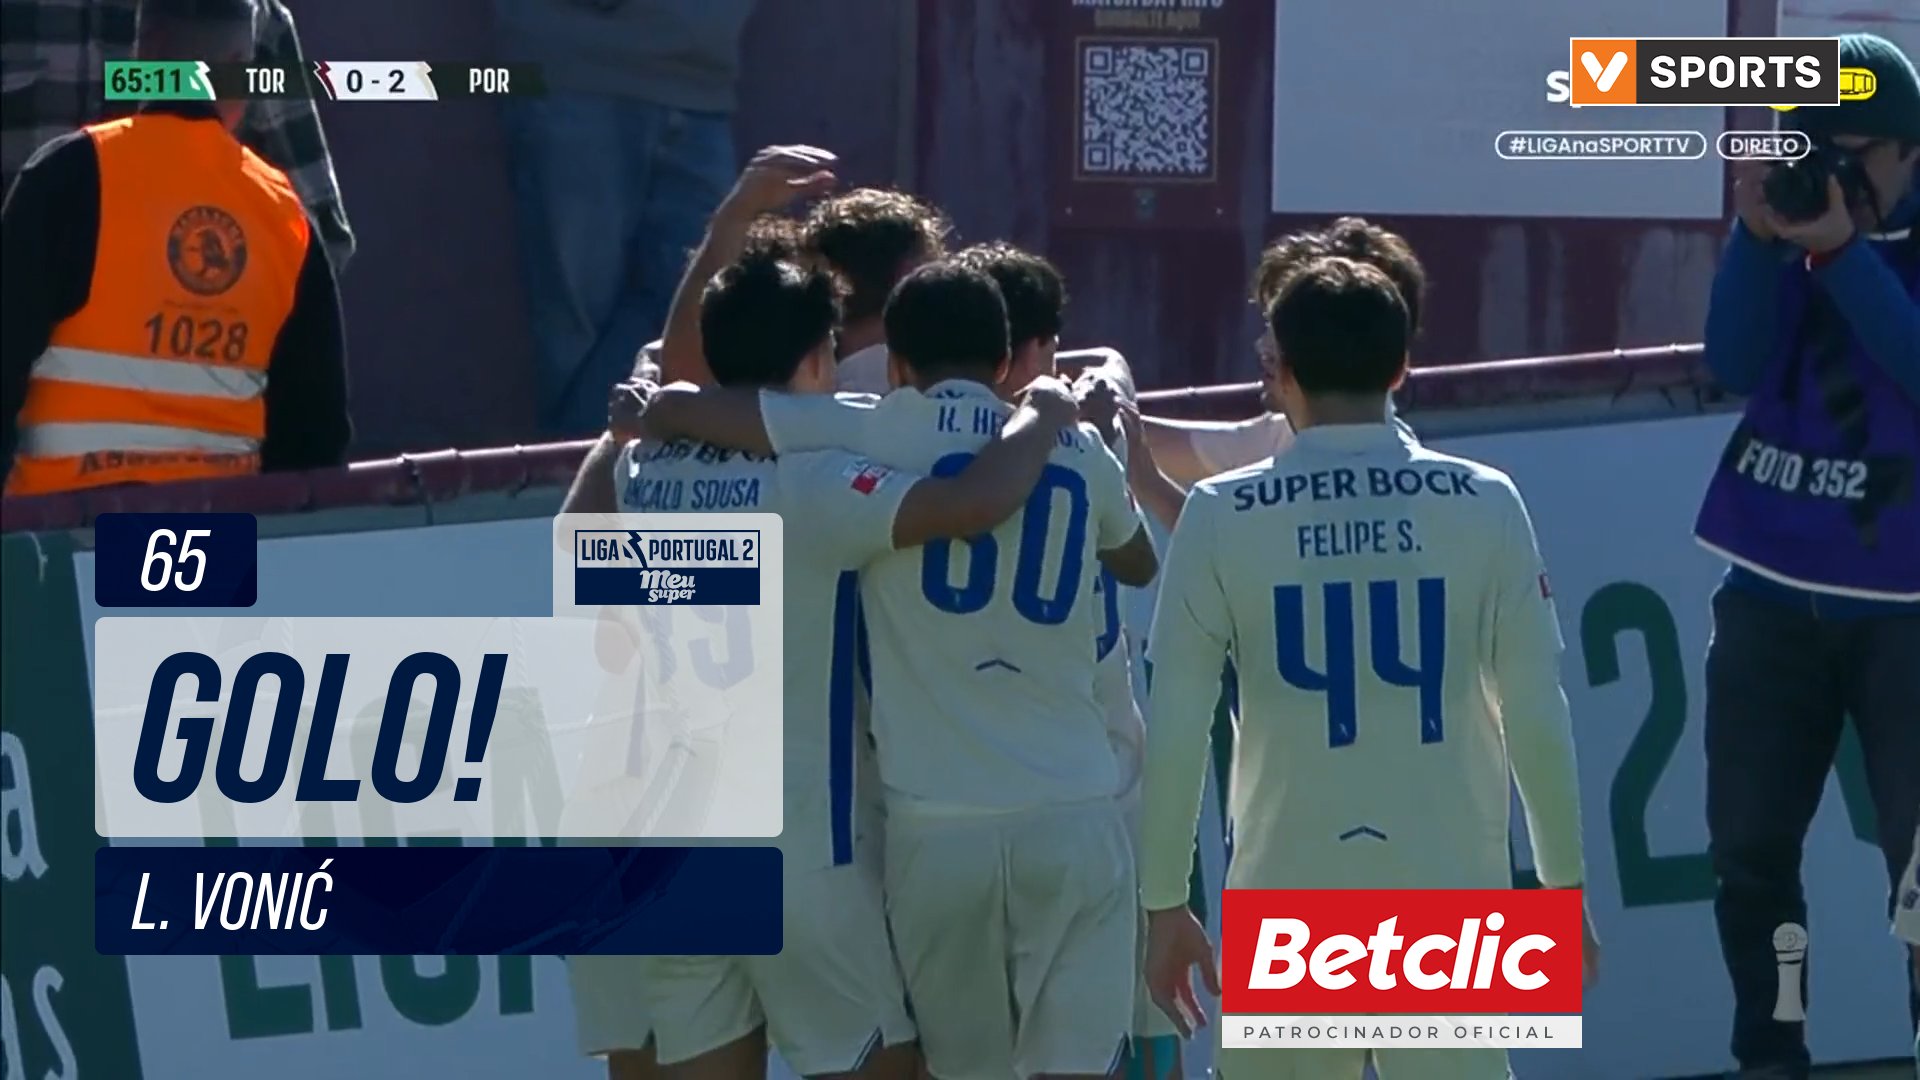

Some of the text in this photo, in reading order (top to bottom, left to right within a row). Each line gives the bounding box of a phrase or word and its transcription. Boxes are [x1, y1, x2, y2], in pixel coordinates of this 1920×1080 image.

[144, 311, 248, 362] 1028
[1233, 467, 1478, 512] SUPER BOCK
[1737, 438, 1868, 499] FOTO 352
[691, 477, 760, 510] SOUSA
[1297, 519, 1423, 559] FELIPE S.
[1273, 577, 1446, 749] 44
